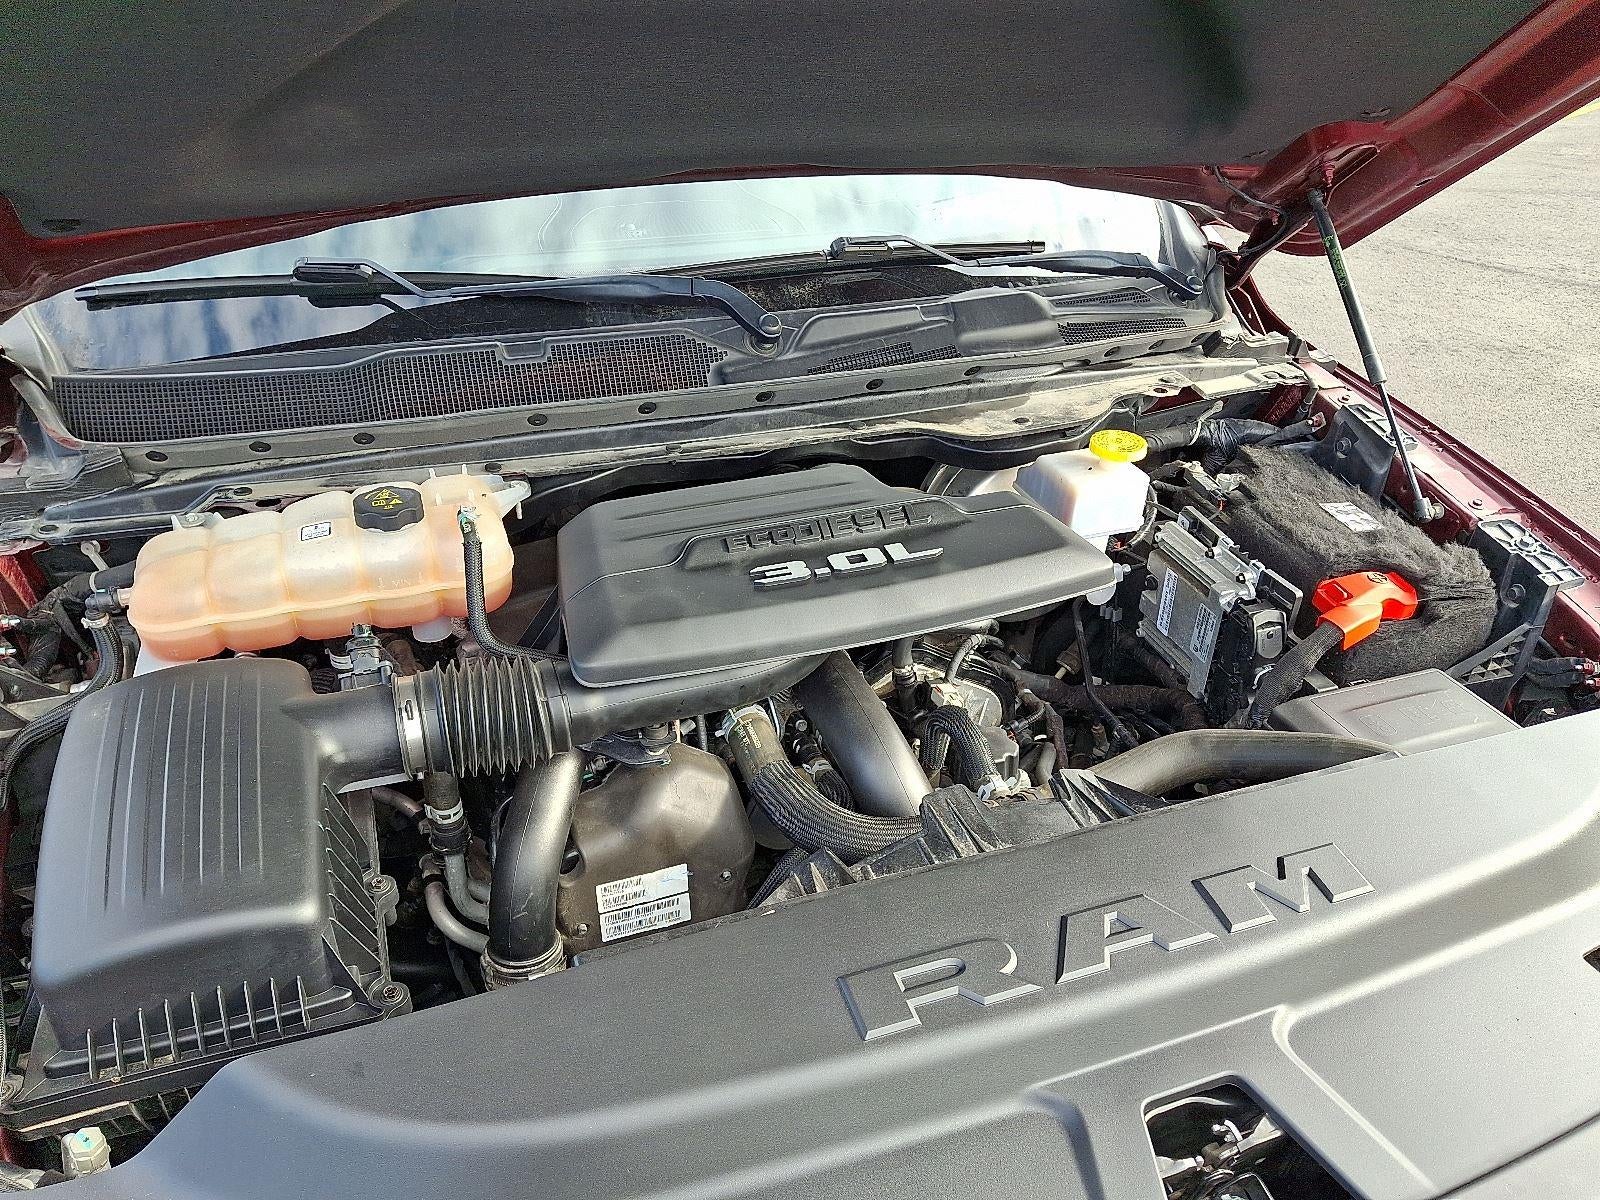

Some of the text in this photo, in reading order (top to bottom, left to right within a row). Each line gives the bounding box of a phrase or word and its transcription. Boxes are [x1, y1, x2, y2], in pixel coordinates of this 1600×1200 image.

[722, 503, 932, 553] ECODIESEL
[749, 542, 944, 588] 3.0L
[836, 842, 1376, 1042] RAM
